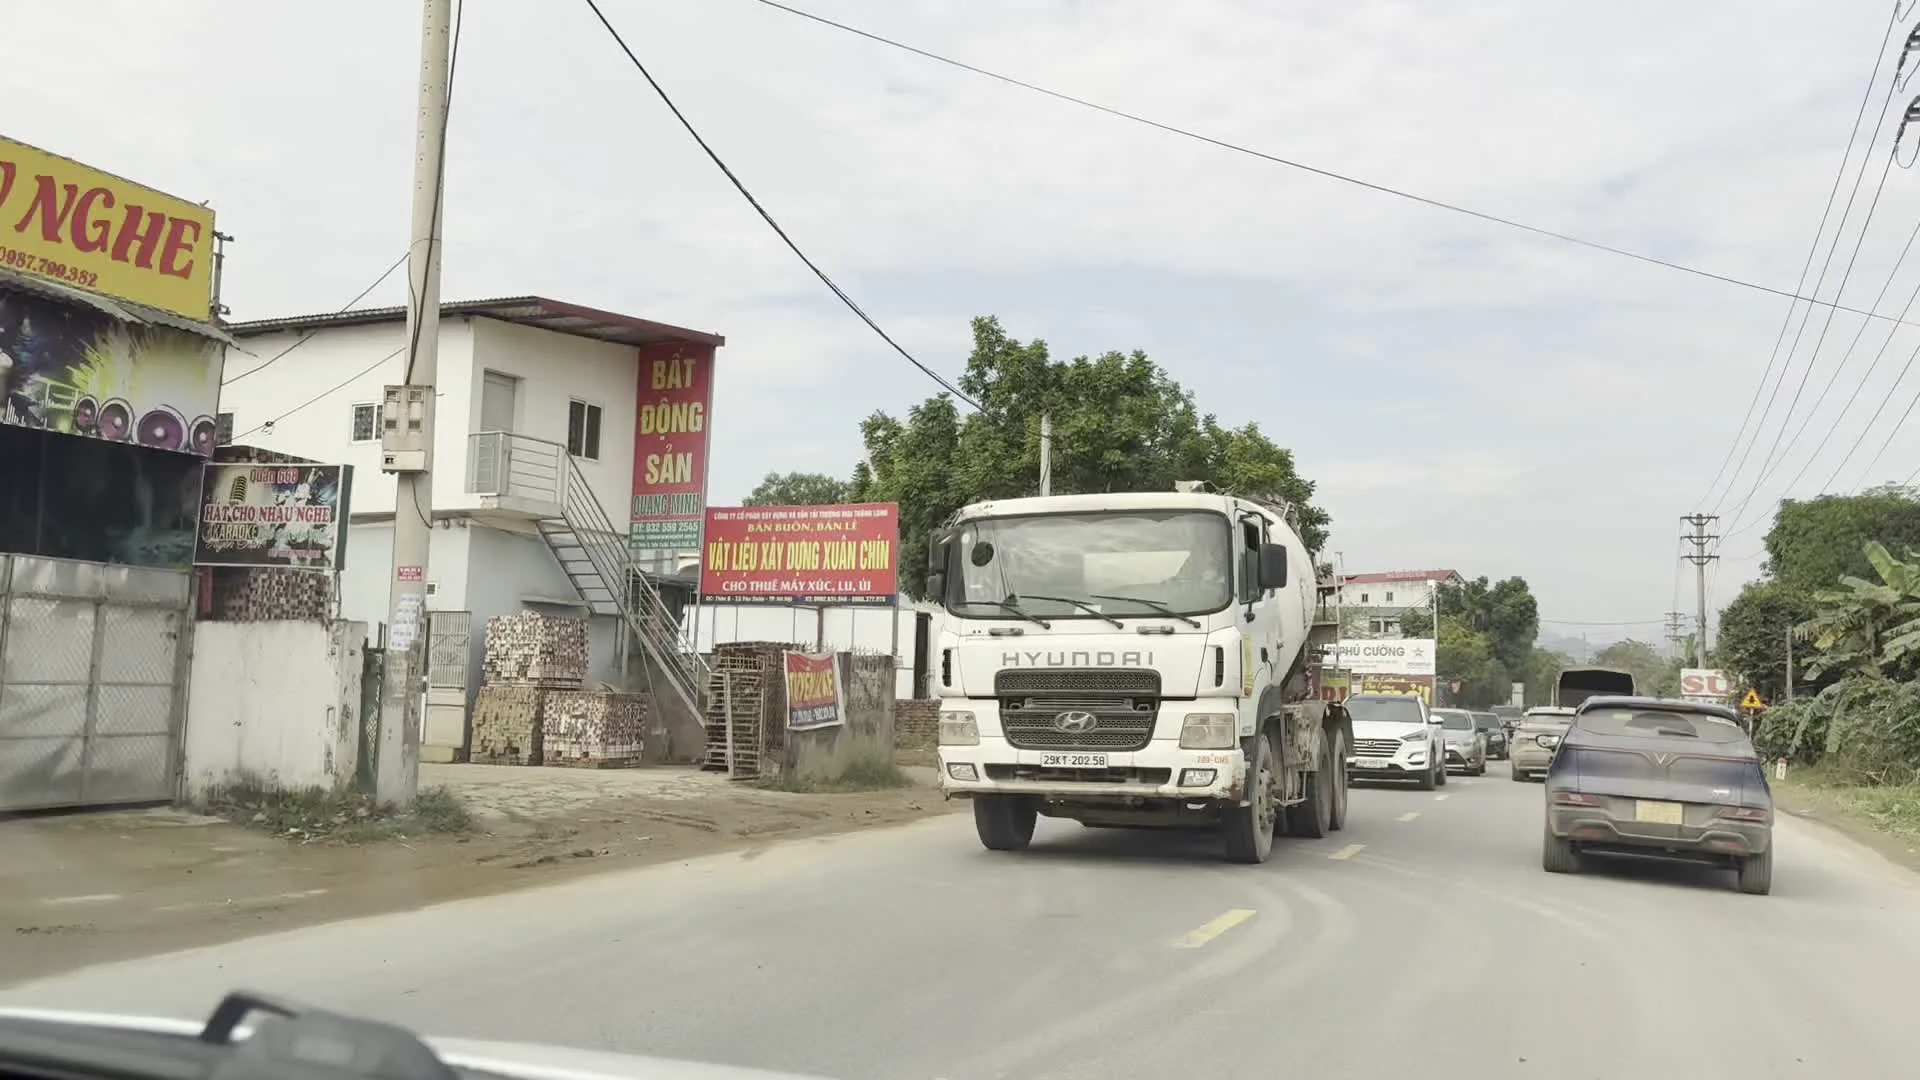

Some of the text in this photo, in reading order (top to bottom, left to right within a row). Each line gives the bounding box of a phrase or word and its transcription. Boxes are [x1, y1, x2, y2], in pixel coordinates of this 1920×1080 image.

[14, 174, 202, 280] NGHE
[652, 347, 697, 391] BẤT
[640, 398, 704, 441] ĐỘNG
[645, 443, 693, 485] SẢN
[232, 505, 256, 522] CHO
[296, 505, 330, 522] NGHE
[671, 492, 700, 515] MINH
[709, 533, 890, 577] VẬT LIỆU XÂY DỰNG XUÂN CHÍN
[722, 580, 746, 592] CHO
[750, 579, 777, 592] THUÊ
[780, 578, 807, 592] MÁY
[1001, 651, 1154, 667] HYUNDAI
